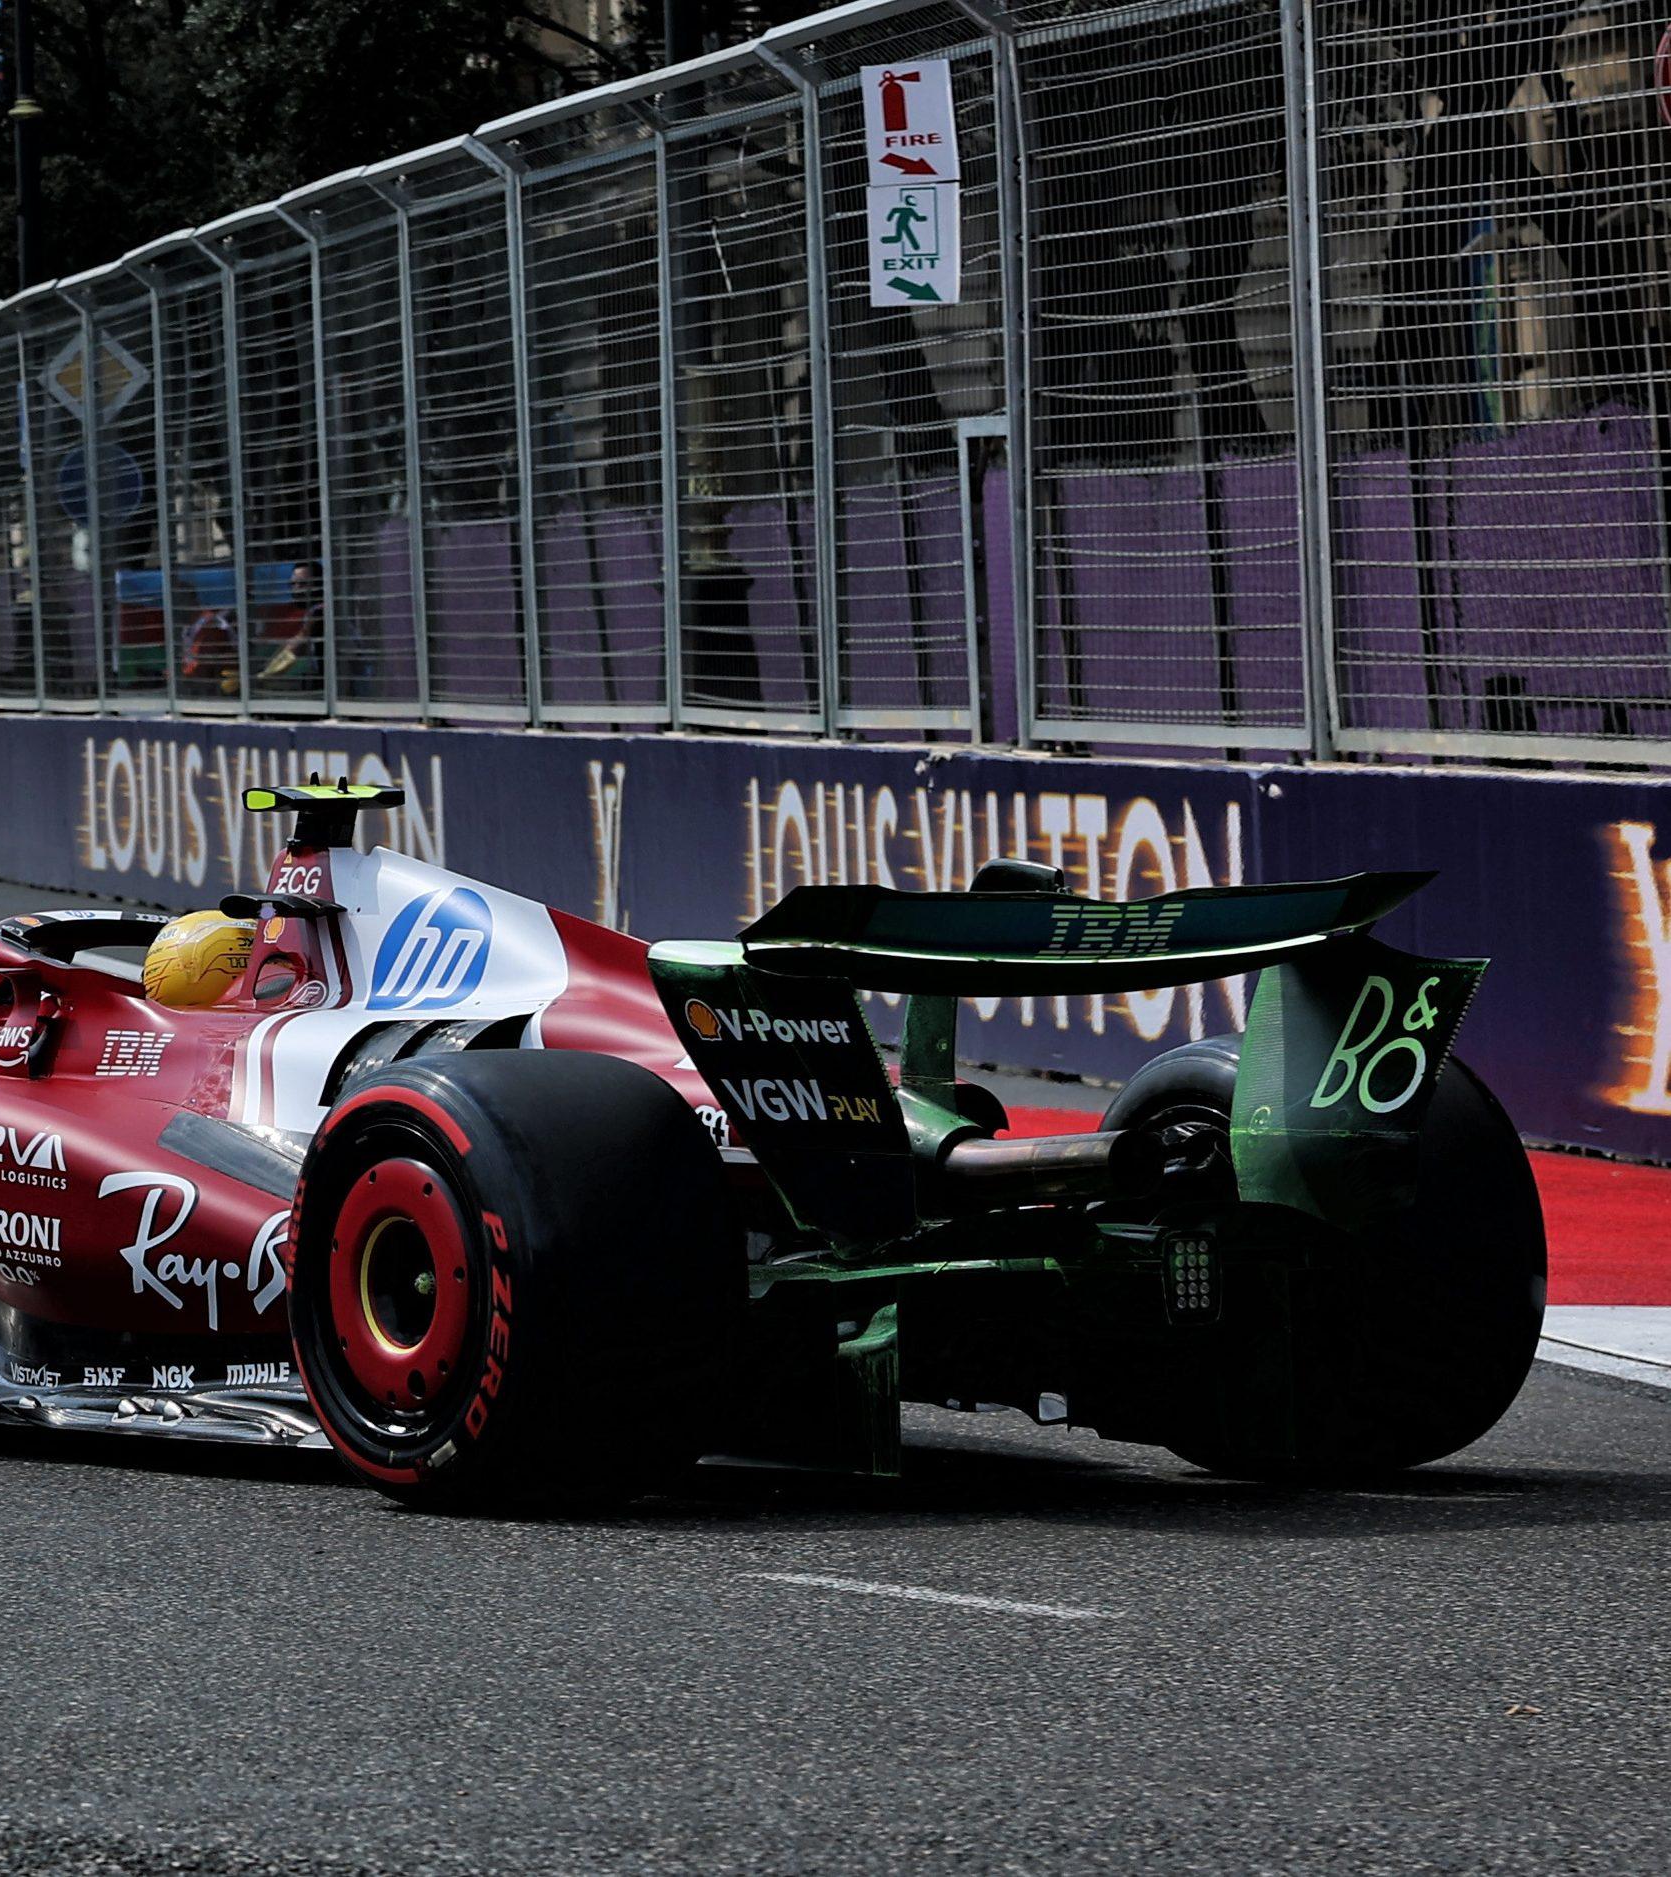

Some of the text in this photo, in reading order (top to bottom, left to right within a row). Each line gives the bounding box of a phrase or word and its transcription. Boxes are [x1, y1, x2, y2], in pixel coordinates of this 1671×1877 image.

[885, 132, 943, 148] FIRE
[882, 257, 940, 271] EXIT
[84, 737, 208, 888] LOUIS
[1035, 903, 1185, 960] IBM
[375, 888, 486, 1010] hp
[715, 1008, 851, 1045] V-Power
[95, 1030, 176, 1076] IBM
[721, 1078, 882, 1124] VGW PLAY
[1, 1169, 68, 1191] LOGISTICS
[6, 1248, 62, 1268] AZZURRO
[464, 1264, 514, 1441] ZERO
[83, 1366, 126, 1387] SKF
[151, 1364, 196, 1389] NGK
[225, 1361, 291, 1386] MAHLE
